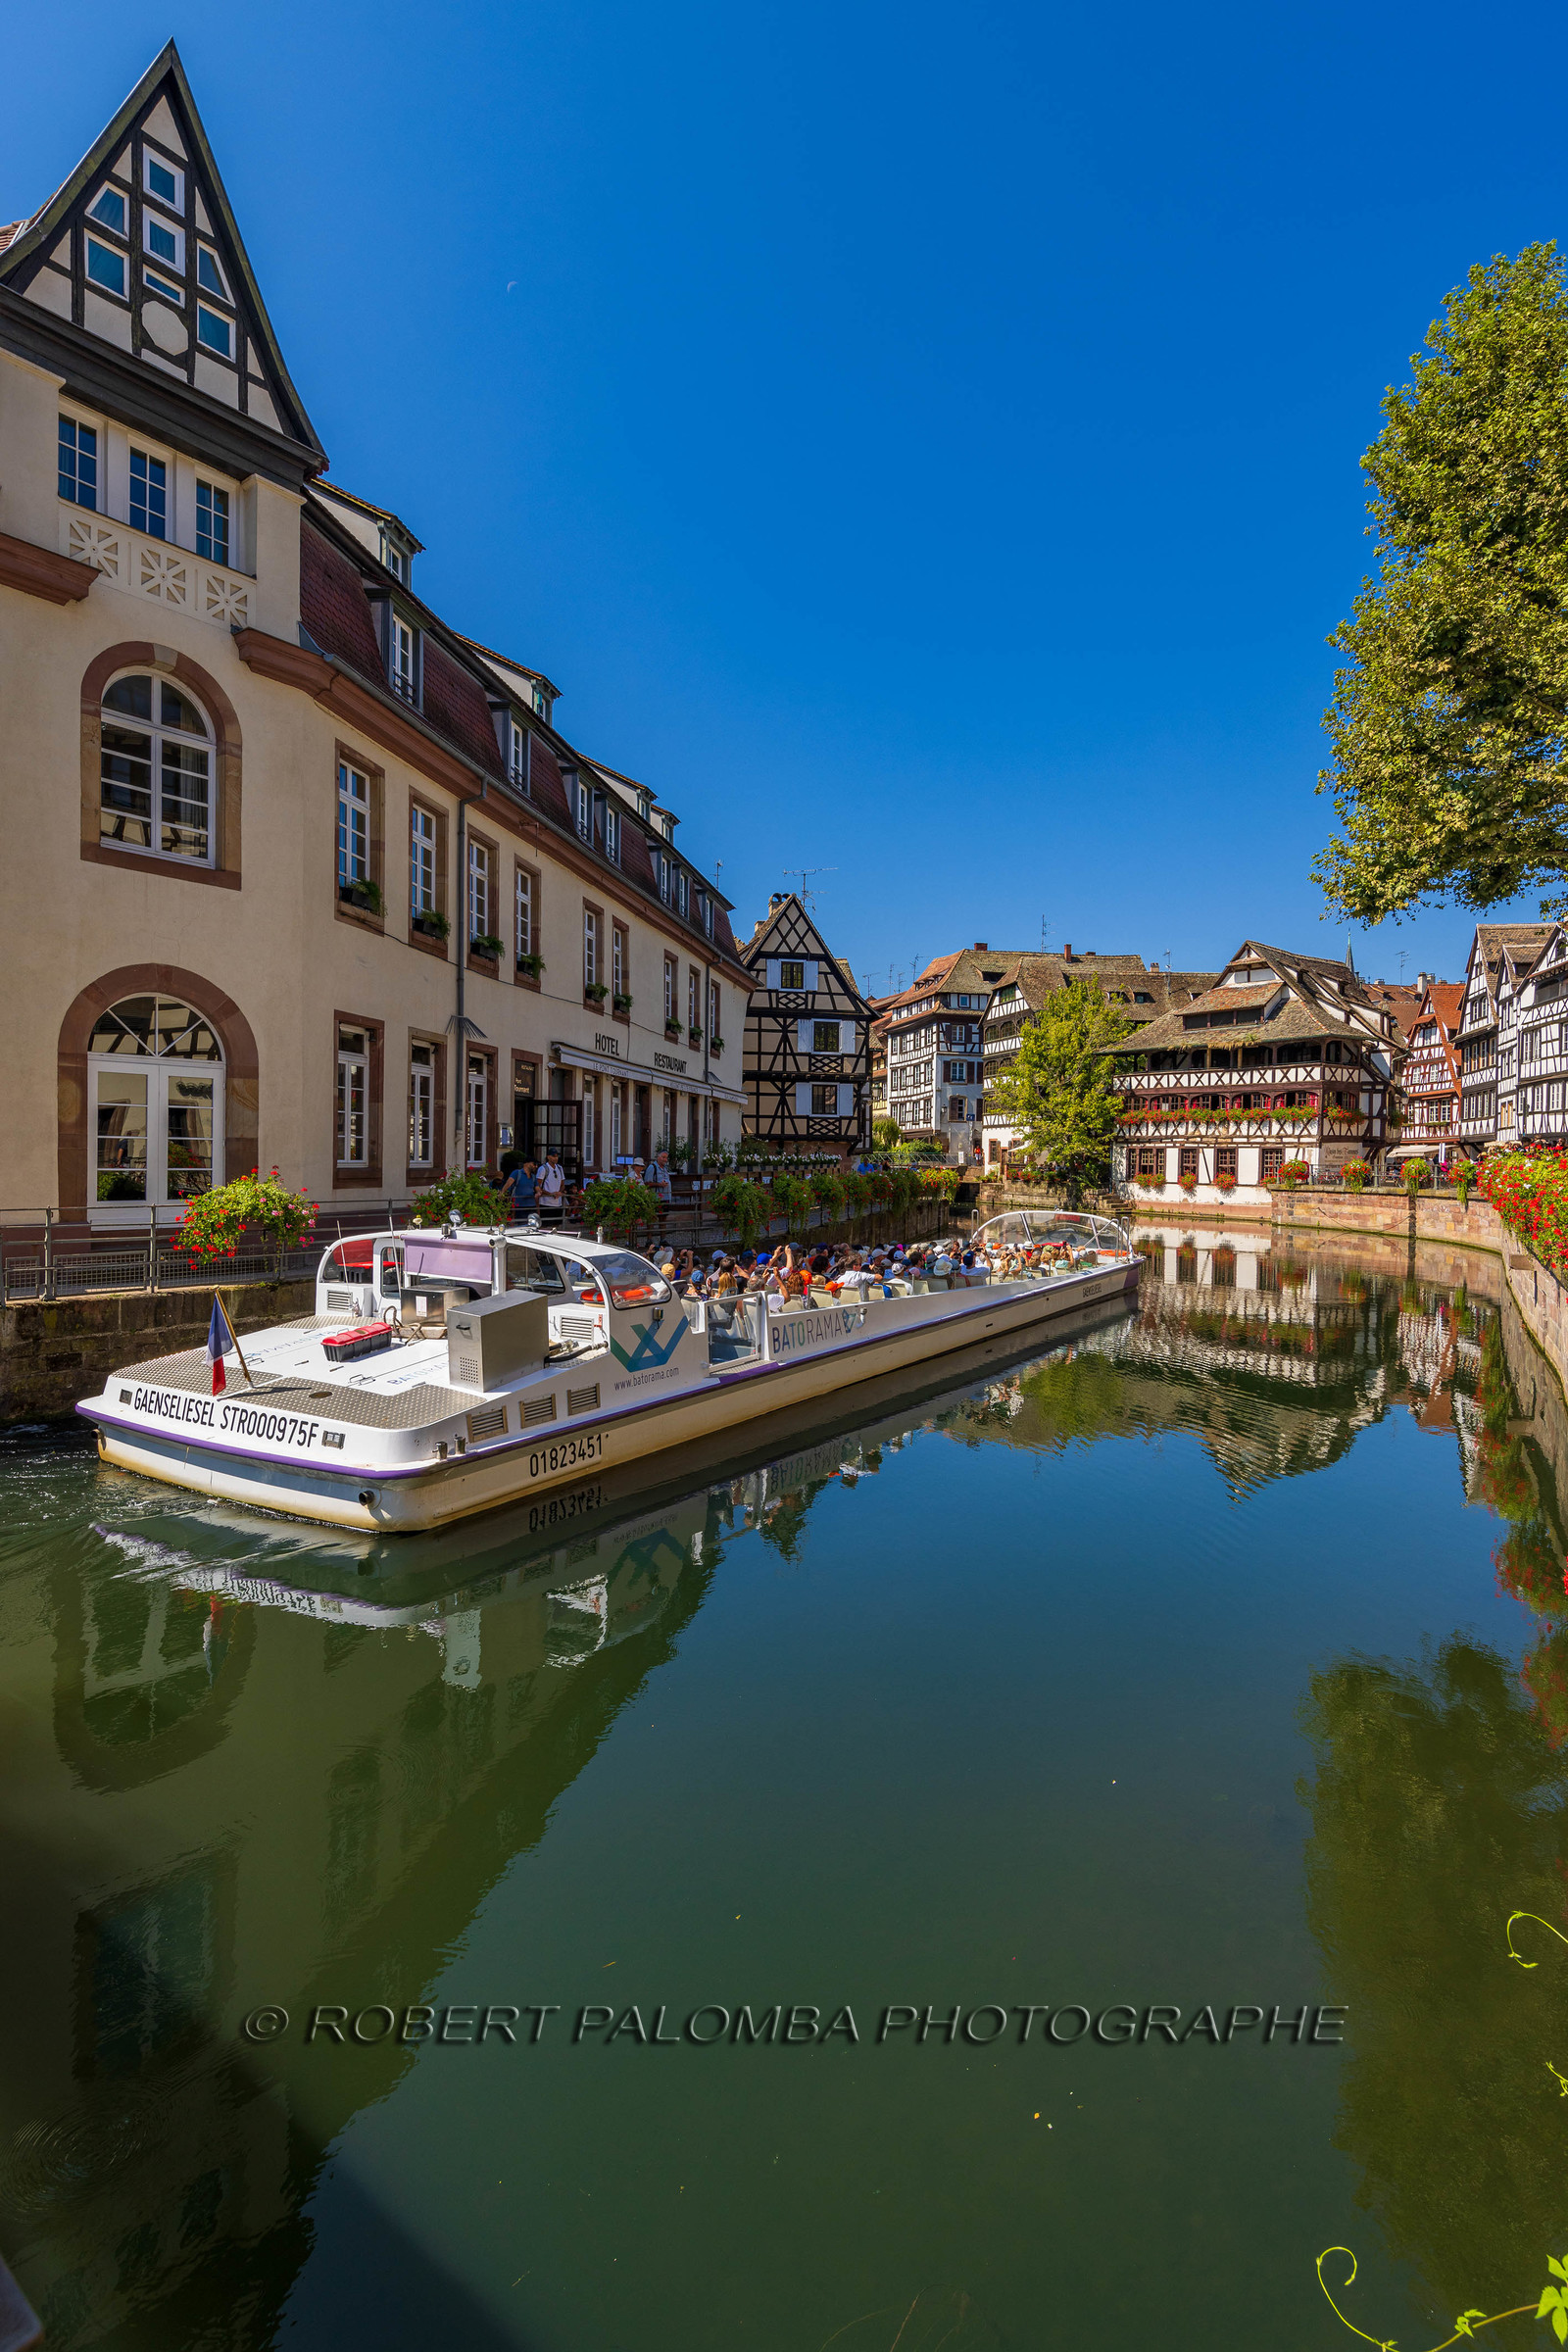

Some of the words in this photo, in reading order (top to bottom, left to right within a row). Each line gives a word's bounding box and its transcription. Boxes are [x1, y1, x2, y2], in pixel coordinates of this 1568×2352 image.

[595, 1033, 619, 1056] HOTEL
[654, 1052, 687, 1074] RESTAURANT
[772, 1312, 843, 1353] BATORAMA
[613, 1366, 680, 1392] www.batorama.com
[133, 1388, 215, 1428] GAENSELIESEL
[220, 1404, 319, 1447] STR000975F
[529, 1434, 602, 1477] 01823451
